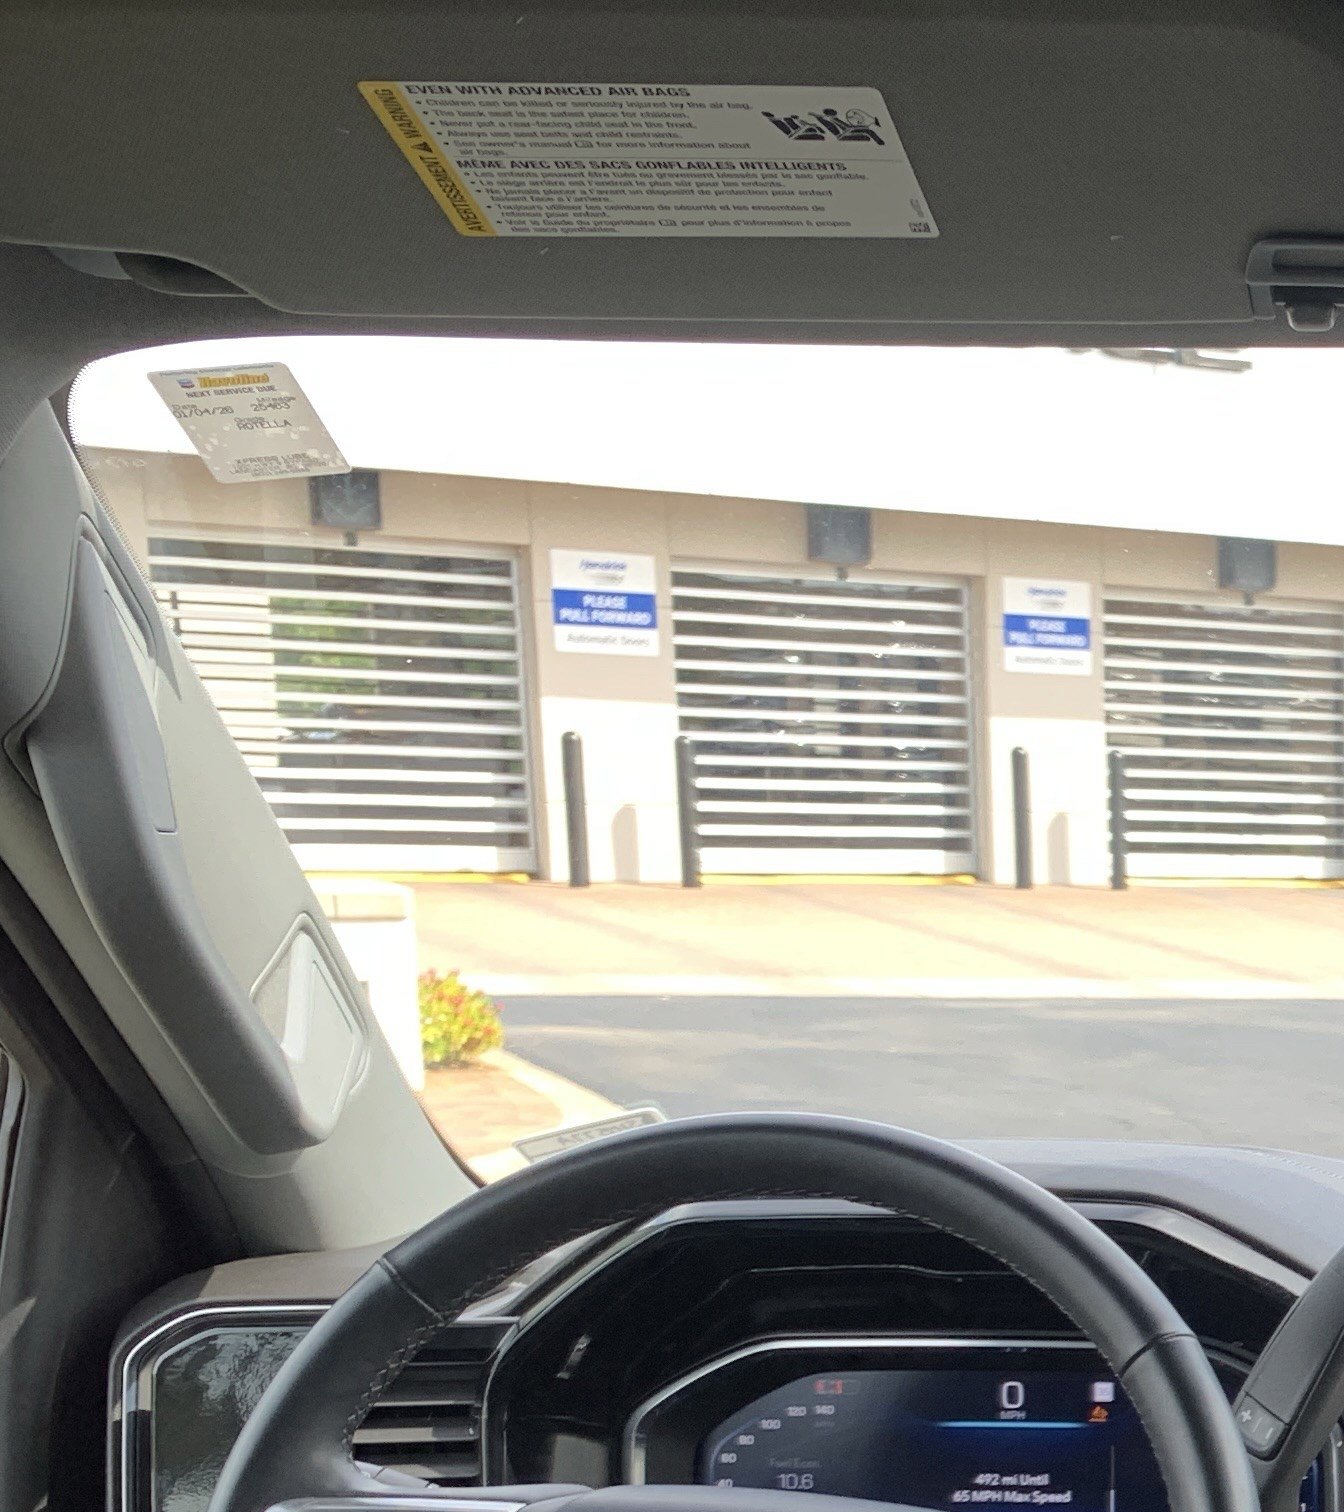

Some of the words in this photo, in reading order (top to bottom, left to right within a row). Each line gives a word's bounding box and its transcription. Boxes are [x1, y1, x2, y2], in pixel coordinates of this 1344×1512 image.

[403, 84, 453, 93] EVEN
[454, 85, 503, 94] WITH
[504, 85, 603, 95] ADVANCED
[605, 86, 638, 95] AIR
[640, 87, 691, 96] BAGS
[453, 159, 506, 168] MÊME
[506, 159, 551, 168] AVEC
[551, 159, 586, 168] DES
[587, 160, 632, 169] SACS
[635, 161, 736, 170] GONFLABLES
[740, 161, 848, 171] INTELLIGENTS
[1001, 1381, 1025, 1410] 0
[974, 1473, 1000, 1486] 492
[1001, 1474, 1018, 1486] mi
[1020, 1473, 1049, 1486] Until
[972, 1489, 1002, 1502] MPH
[1004, 1490, 1031, 1502] Max
[1032, 1490, 1072, 1505] Speed
